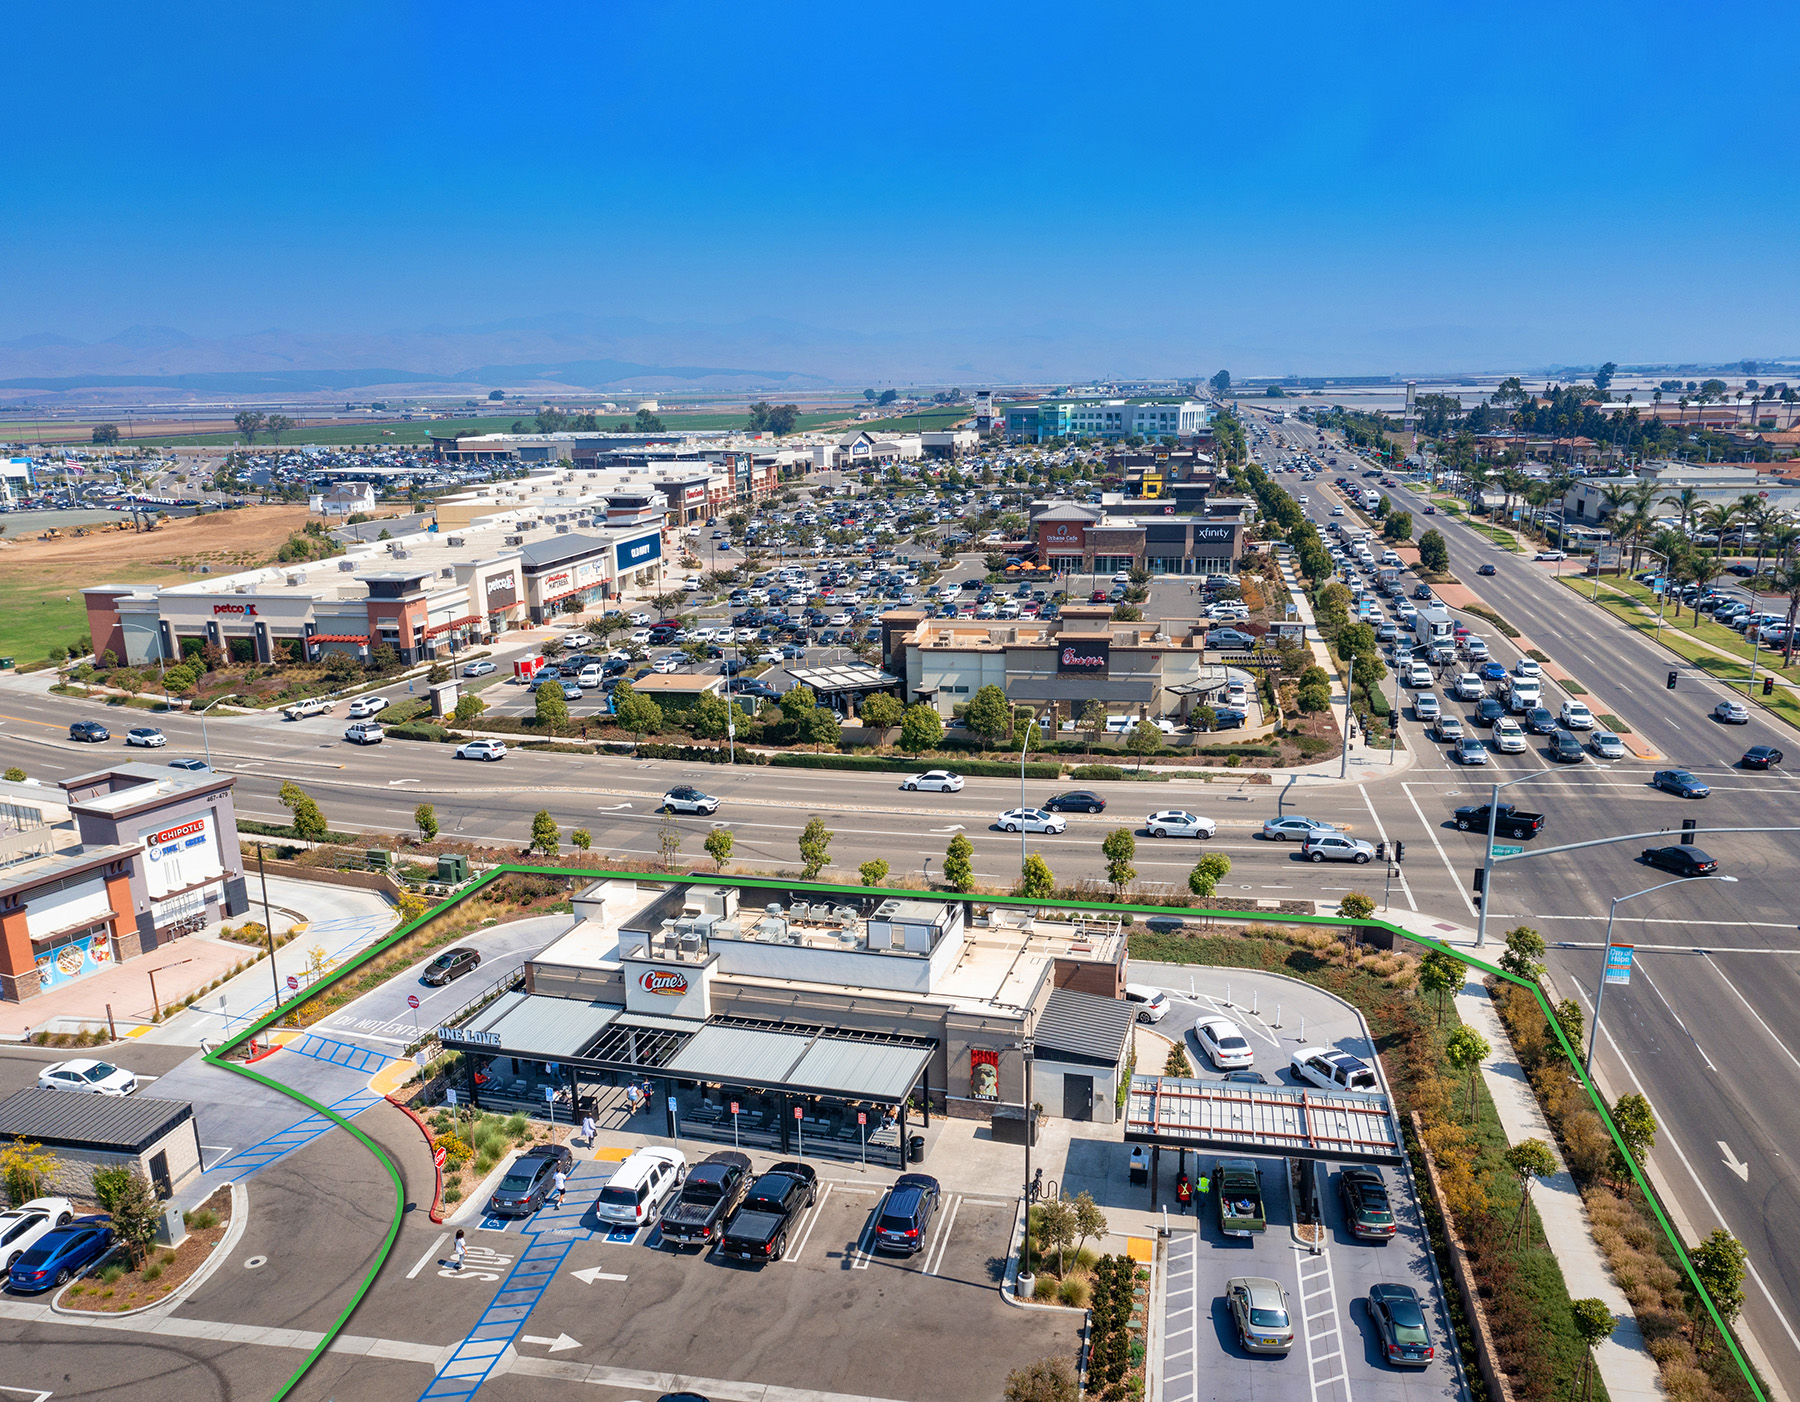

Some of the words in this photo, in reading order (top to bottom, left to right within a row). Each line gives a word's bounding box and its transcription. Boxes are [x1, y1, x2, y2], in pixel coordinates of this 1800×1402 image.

[1199, 527, 1230, 538] xfinity
[487, 577, 506, 594] petco
[213, 603, 245, 615] petco
[161, 821, 204, 841] CHIPOTLE
[1611, 955, 1630, 963] Hope
[641, 970, 686, 992] Cane's
[333, 1015, 357, 1026] DO
[354, 1018, 386, 1030] NOT
[437, 1027, 464, 1041] ONE
[465, 1030, 501, 1046] LOVE
